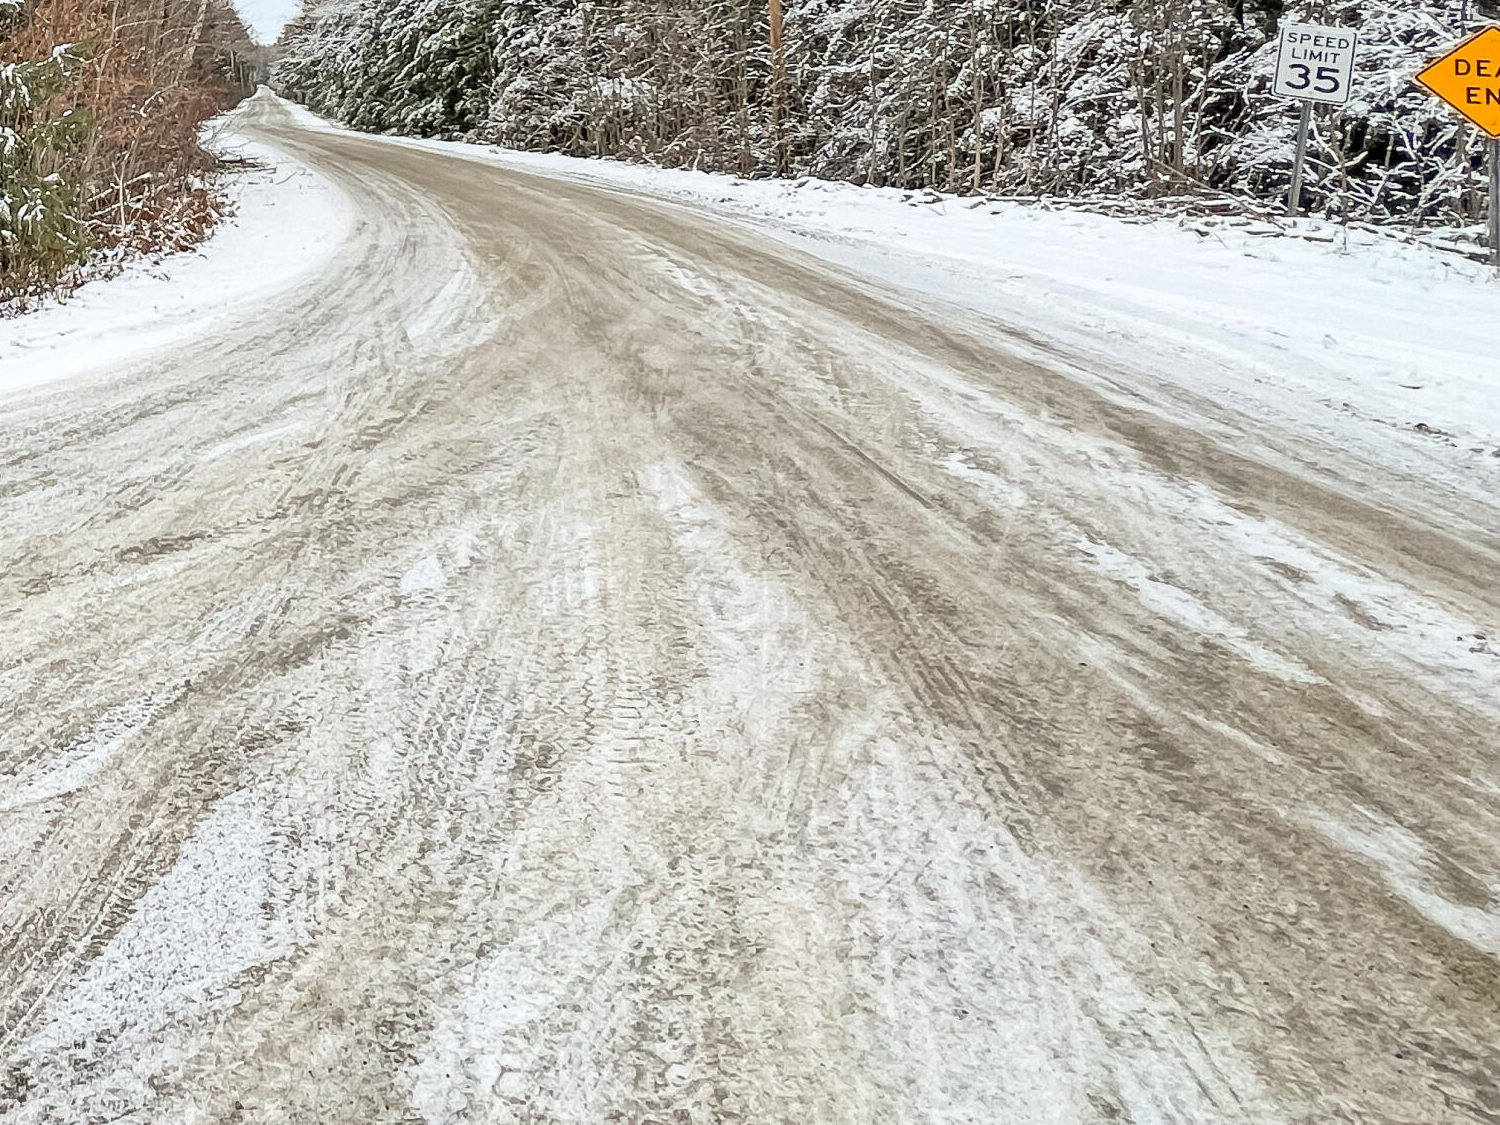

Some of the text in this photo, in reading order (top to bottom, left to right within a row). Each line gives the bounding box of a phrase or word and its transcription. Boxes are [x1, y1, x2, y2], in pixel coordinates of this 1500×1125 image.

[1286, 32, 1349, 50] SPEED
[1291, 47, 1341, 64] LIMIT
[1284, 63, 1341, 94] 35
